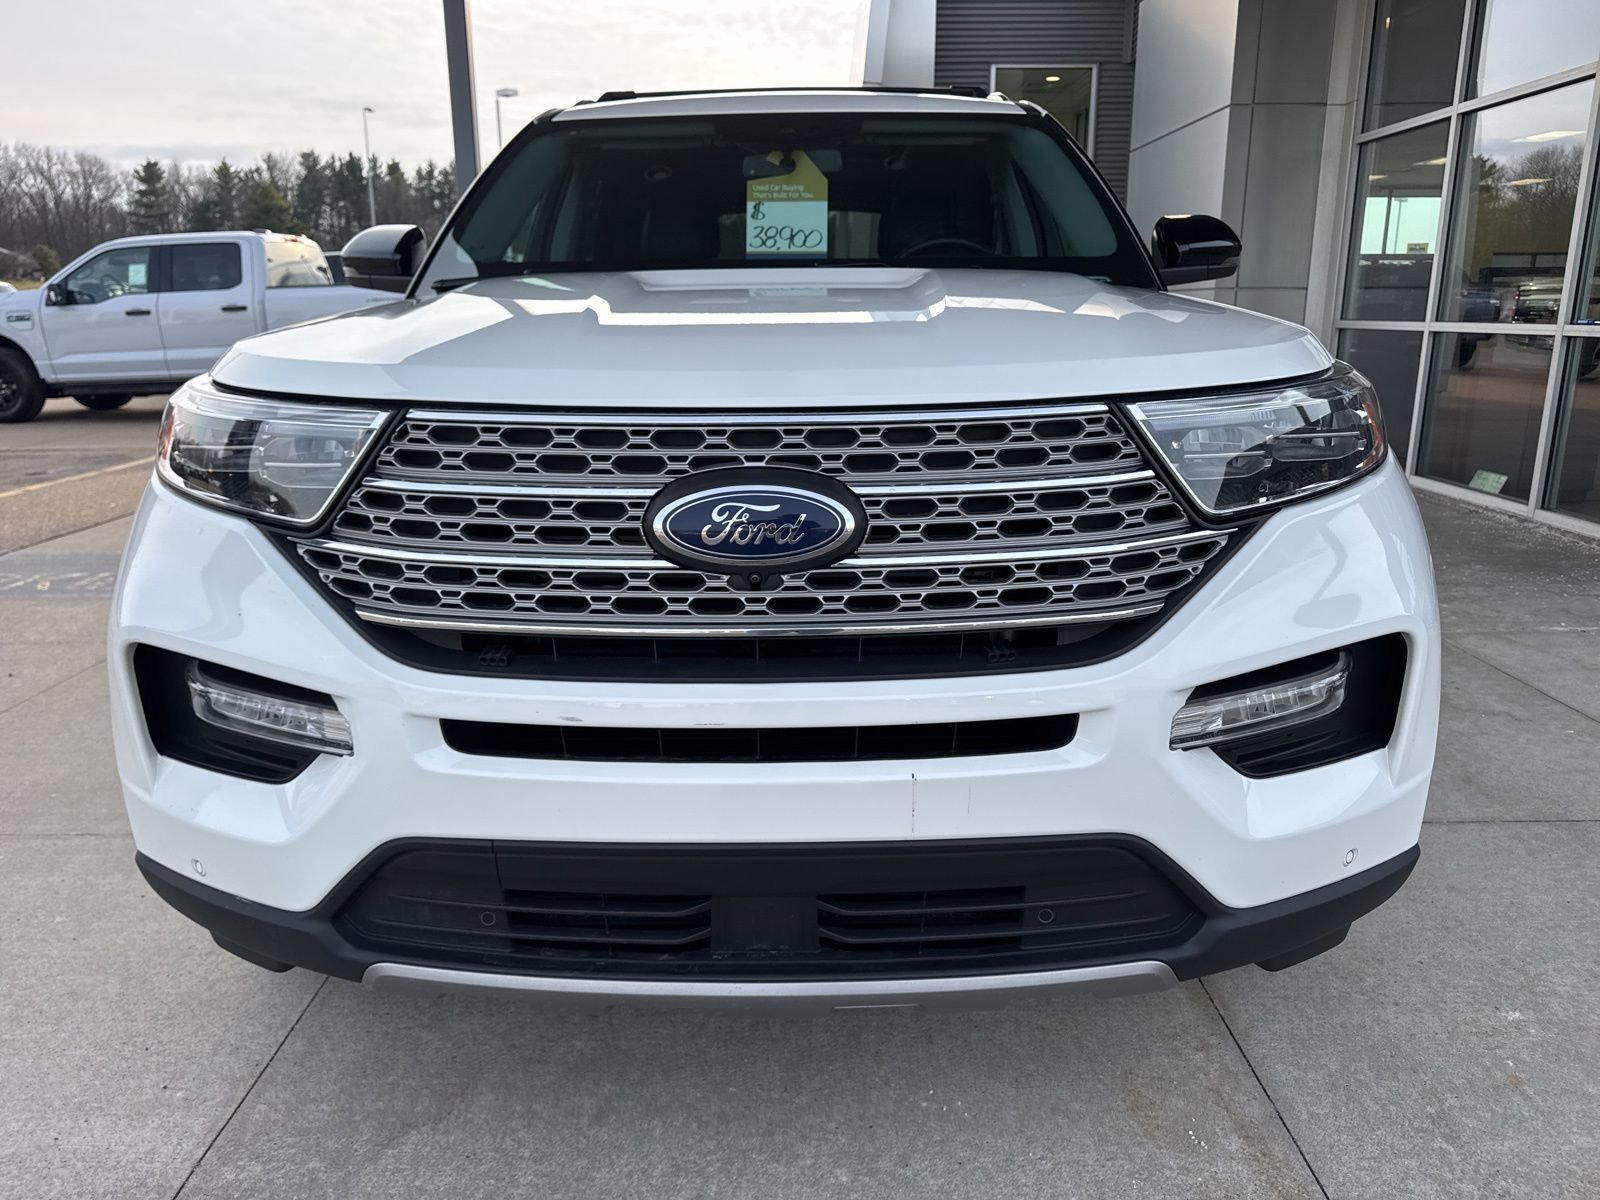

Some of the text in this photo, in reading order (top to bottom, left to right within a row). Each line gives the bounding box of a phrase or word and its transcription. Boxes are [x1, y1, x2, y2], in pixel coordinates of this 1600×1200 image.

[782, 184, 804, 192] Buying
[750, 201, 766, 221] $
[749, 226, 823, 251] 38,900
[701, 502, 807, 546] Ford
